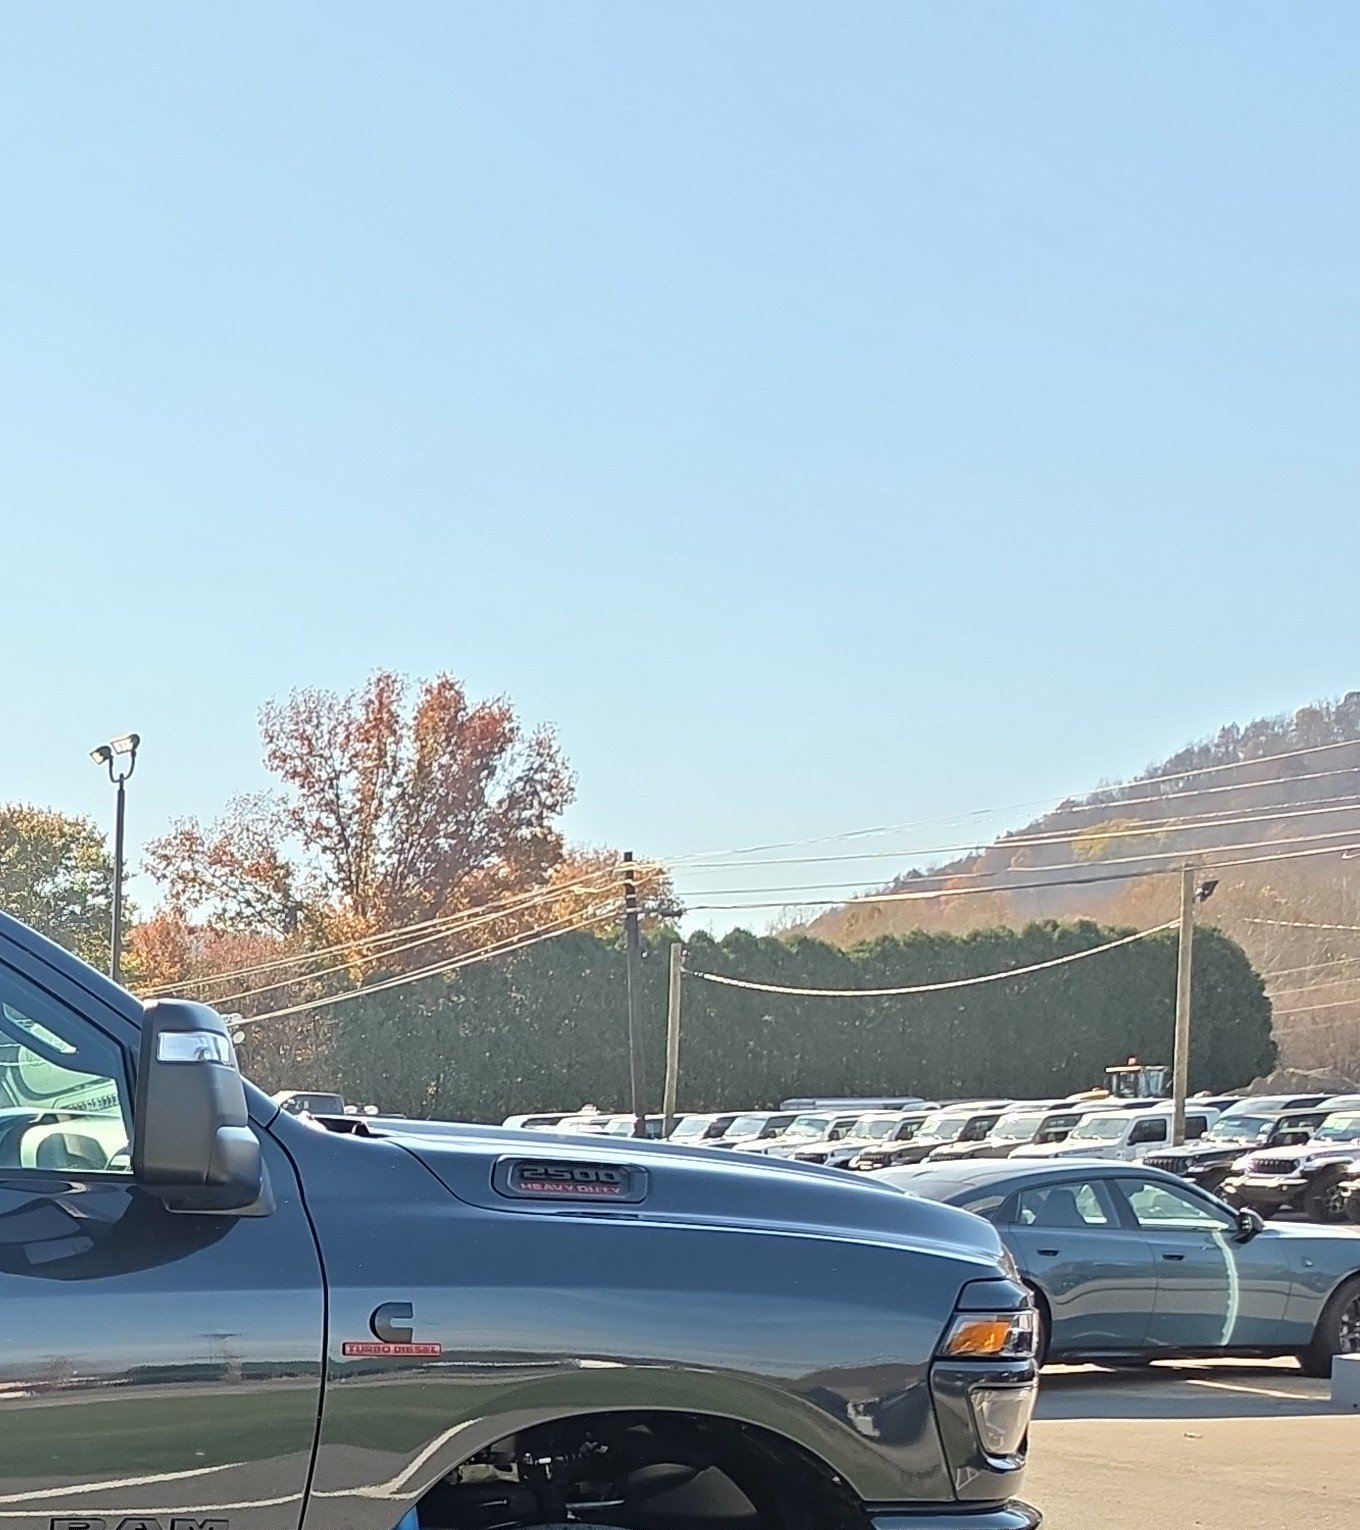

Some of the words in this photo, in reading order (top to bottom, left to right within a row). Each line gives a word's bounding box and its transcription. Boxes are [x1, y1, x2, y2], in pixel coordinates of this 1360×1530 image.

[520, 1166, 621, 1184] 2500
[520, 1182, 573, 1192] HEAVY
[393, 1345, 438, 1354] DIESEL
